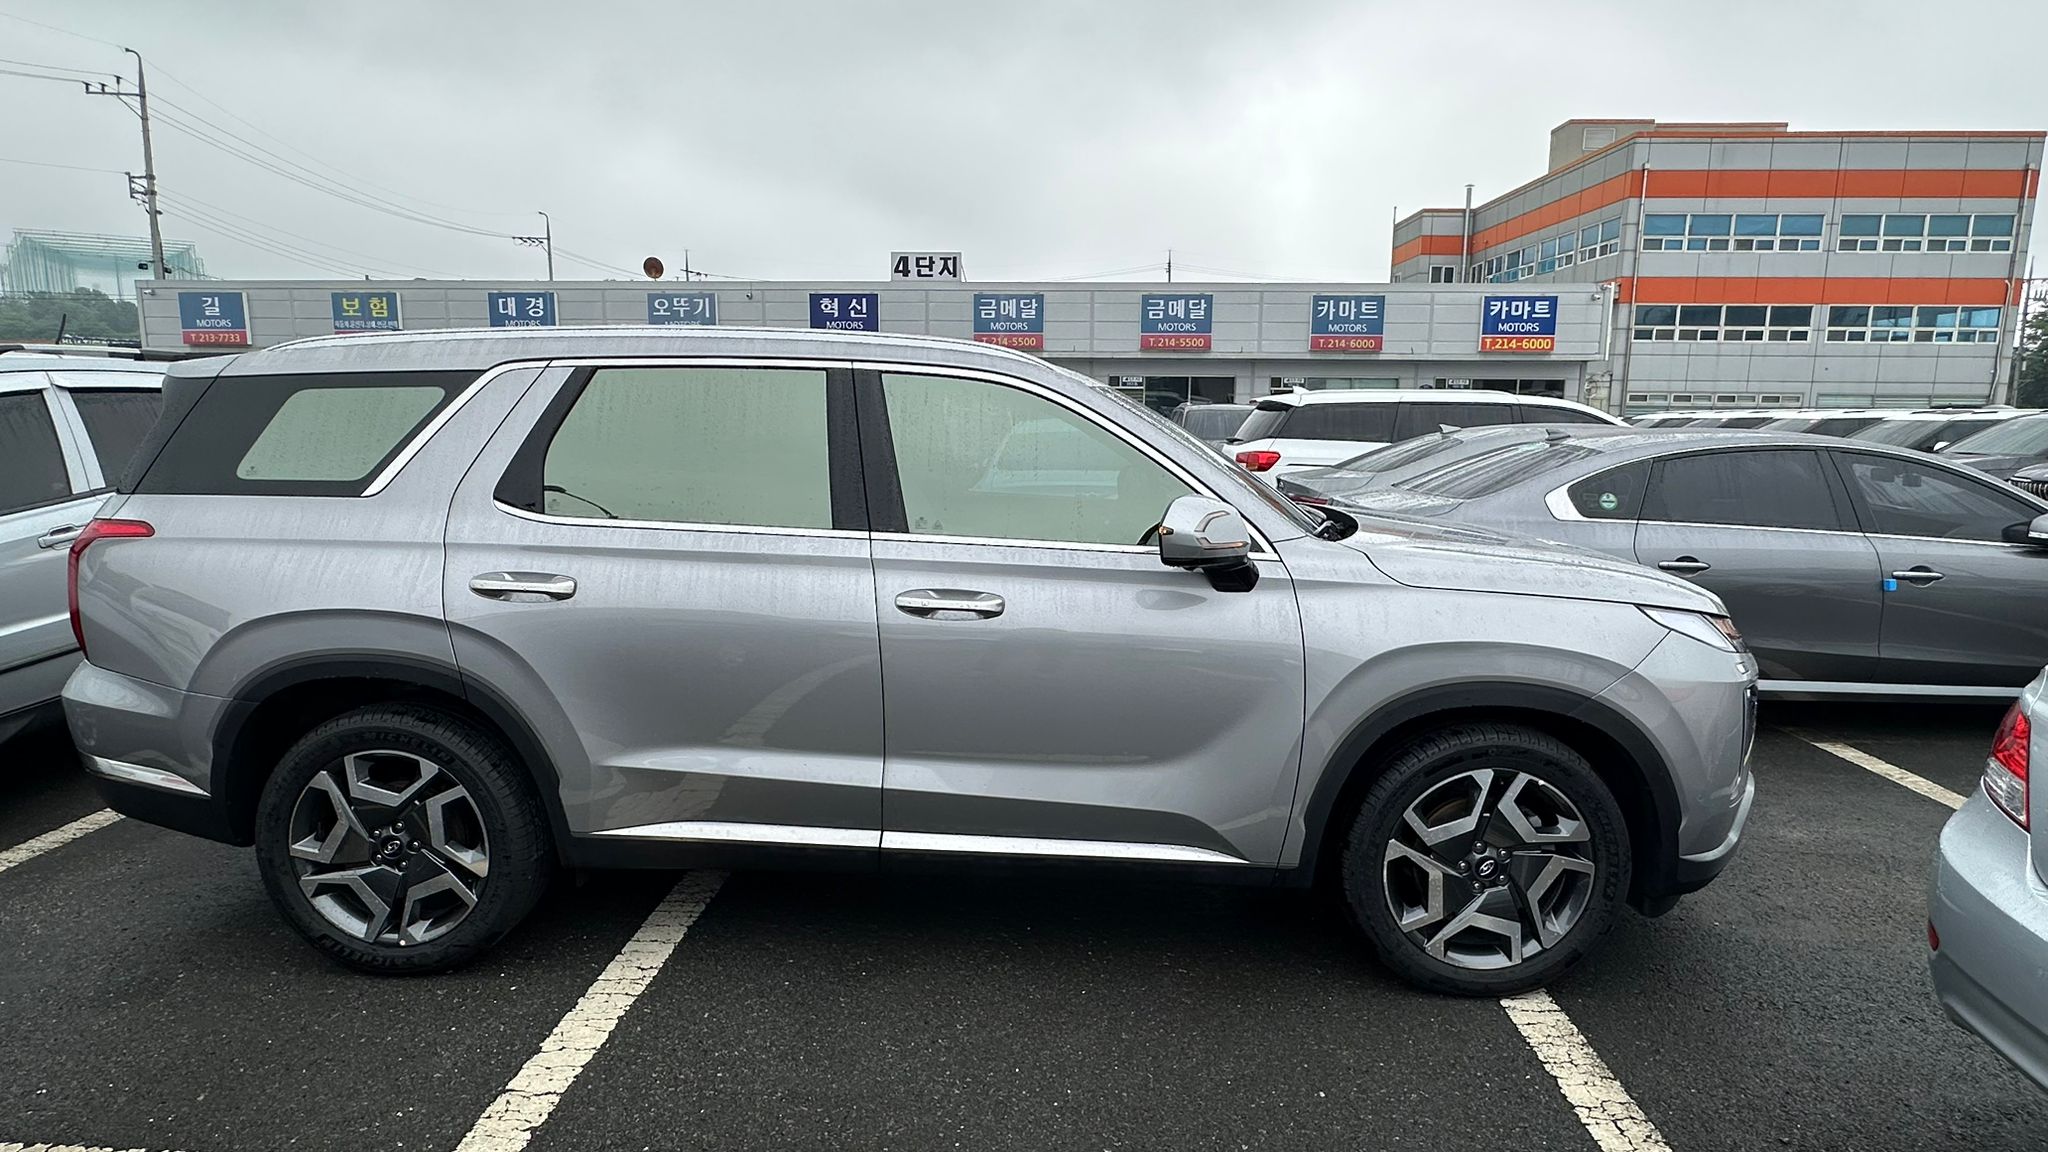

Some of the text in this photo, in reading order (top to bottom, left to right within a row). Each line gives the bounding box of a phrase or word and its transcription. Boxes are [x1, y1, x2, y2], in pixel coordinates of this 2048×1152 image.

[894, 255, 957, 278] 4단지
[202, 296, 220, 316] 길
[653, 297, 710, 318] 오뚜기
[979, 298, 1038, 319] 금메달
[1147, 299, 1207, 319] 금메달
[1317, 300, 1378, 320] 카마트
[1490, 300, 1551, 320] 카마트
[196, 319, 232, 328] MOTORS
[826, 321, 864, 330] MOTORS
[990, 322, 1028, 331] MOTORS
[1158, 322, 1197, 331] MOTORS
[1328, 323, 1367, 333] MOTORS
[1497, 322, 1540, 332] MOTORS
[190, 333, 241, 343] T.213-7733
[1149, 338, 1204, 347] T.214-5500
[1318, 339, 1375, 349] T.214-6000
[1484, 338, 1552, 350] T.214-6000
